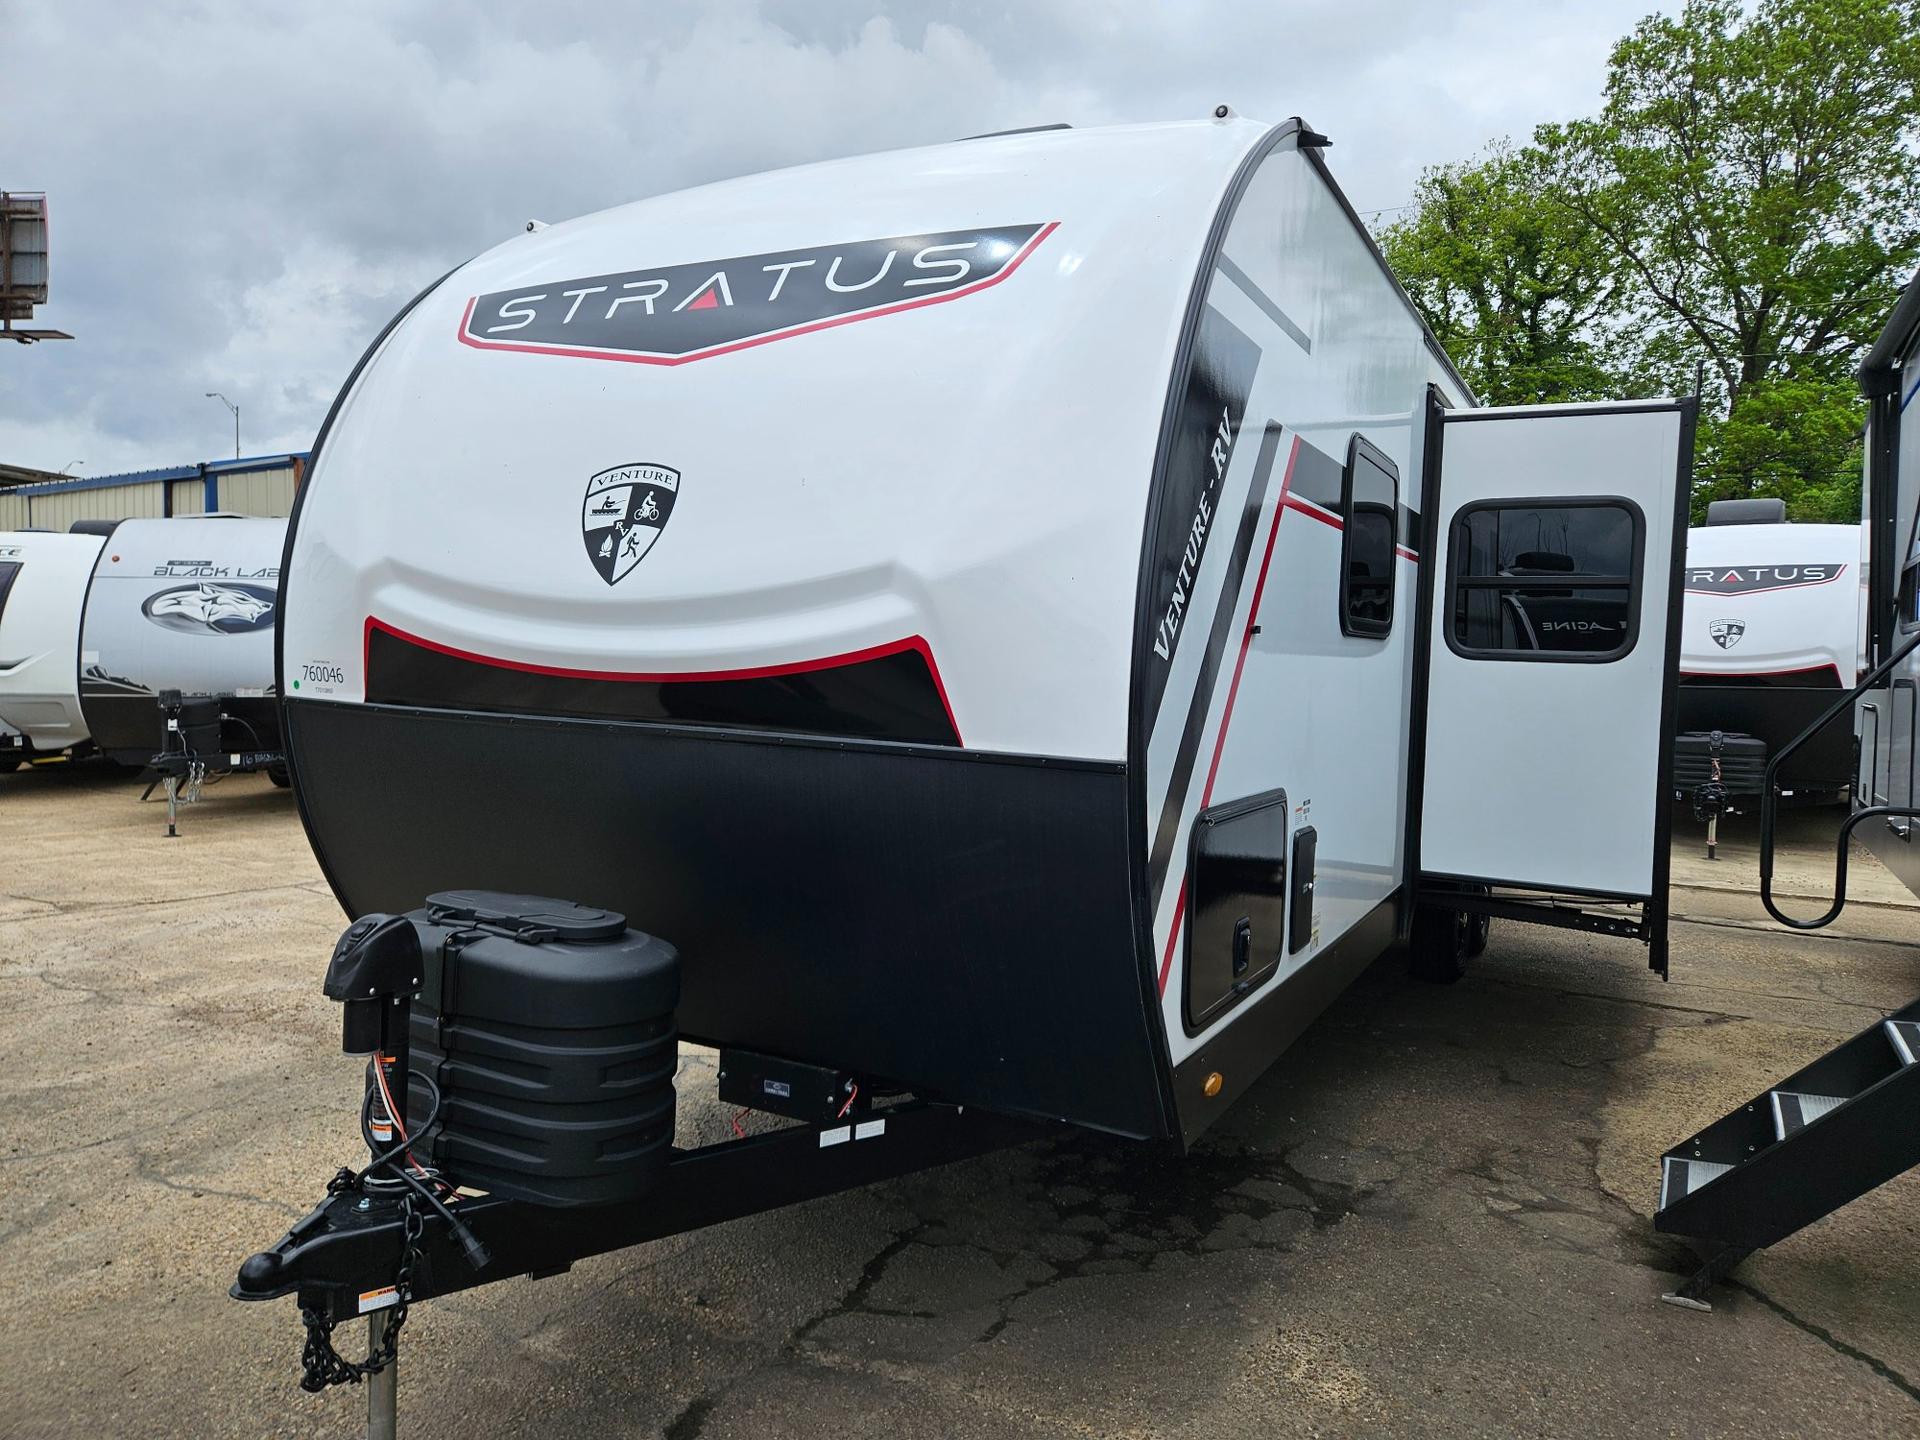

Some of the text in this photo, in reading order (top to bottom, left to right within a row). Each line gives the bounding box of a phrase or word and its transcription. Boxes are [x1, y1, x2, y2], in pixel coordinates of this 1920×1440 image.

[487, 242, 978, 333] STRATUS
[597, 469, 673, 487] VENTURE
[1153, 491, 1211, 662] VENTURE
[1210, 406, 1232, 480] RV
[153, 565, 280, 578] BLACK LAB
[1684, 567, 1826, 583] RATUS
[302, 664, 344, 684] 760046
